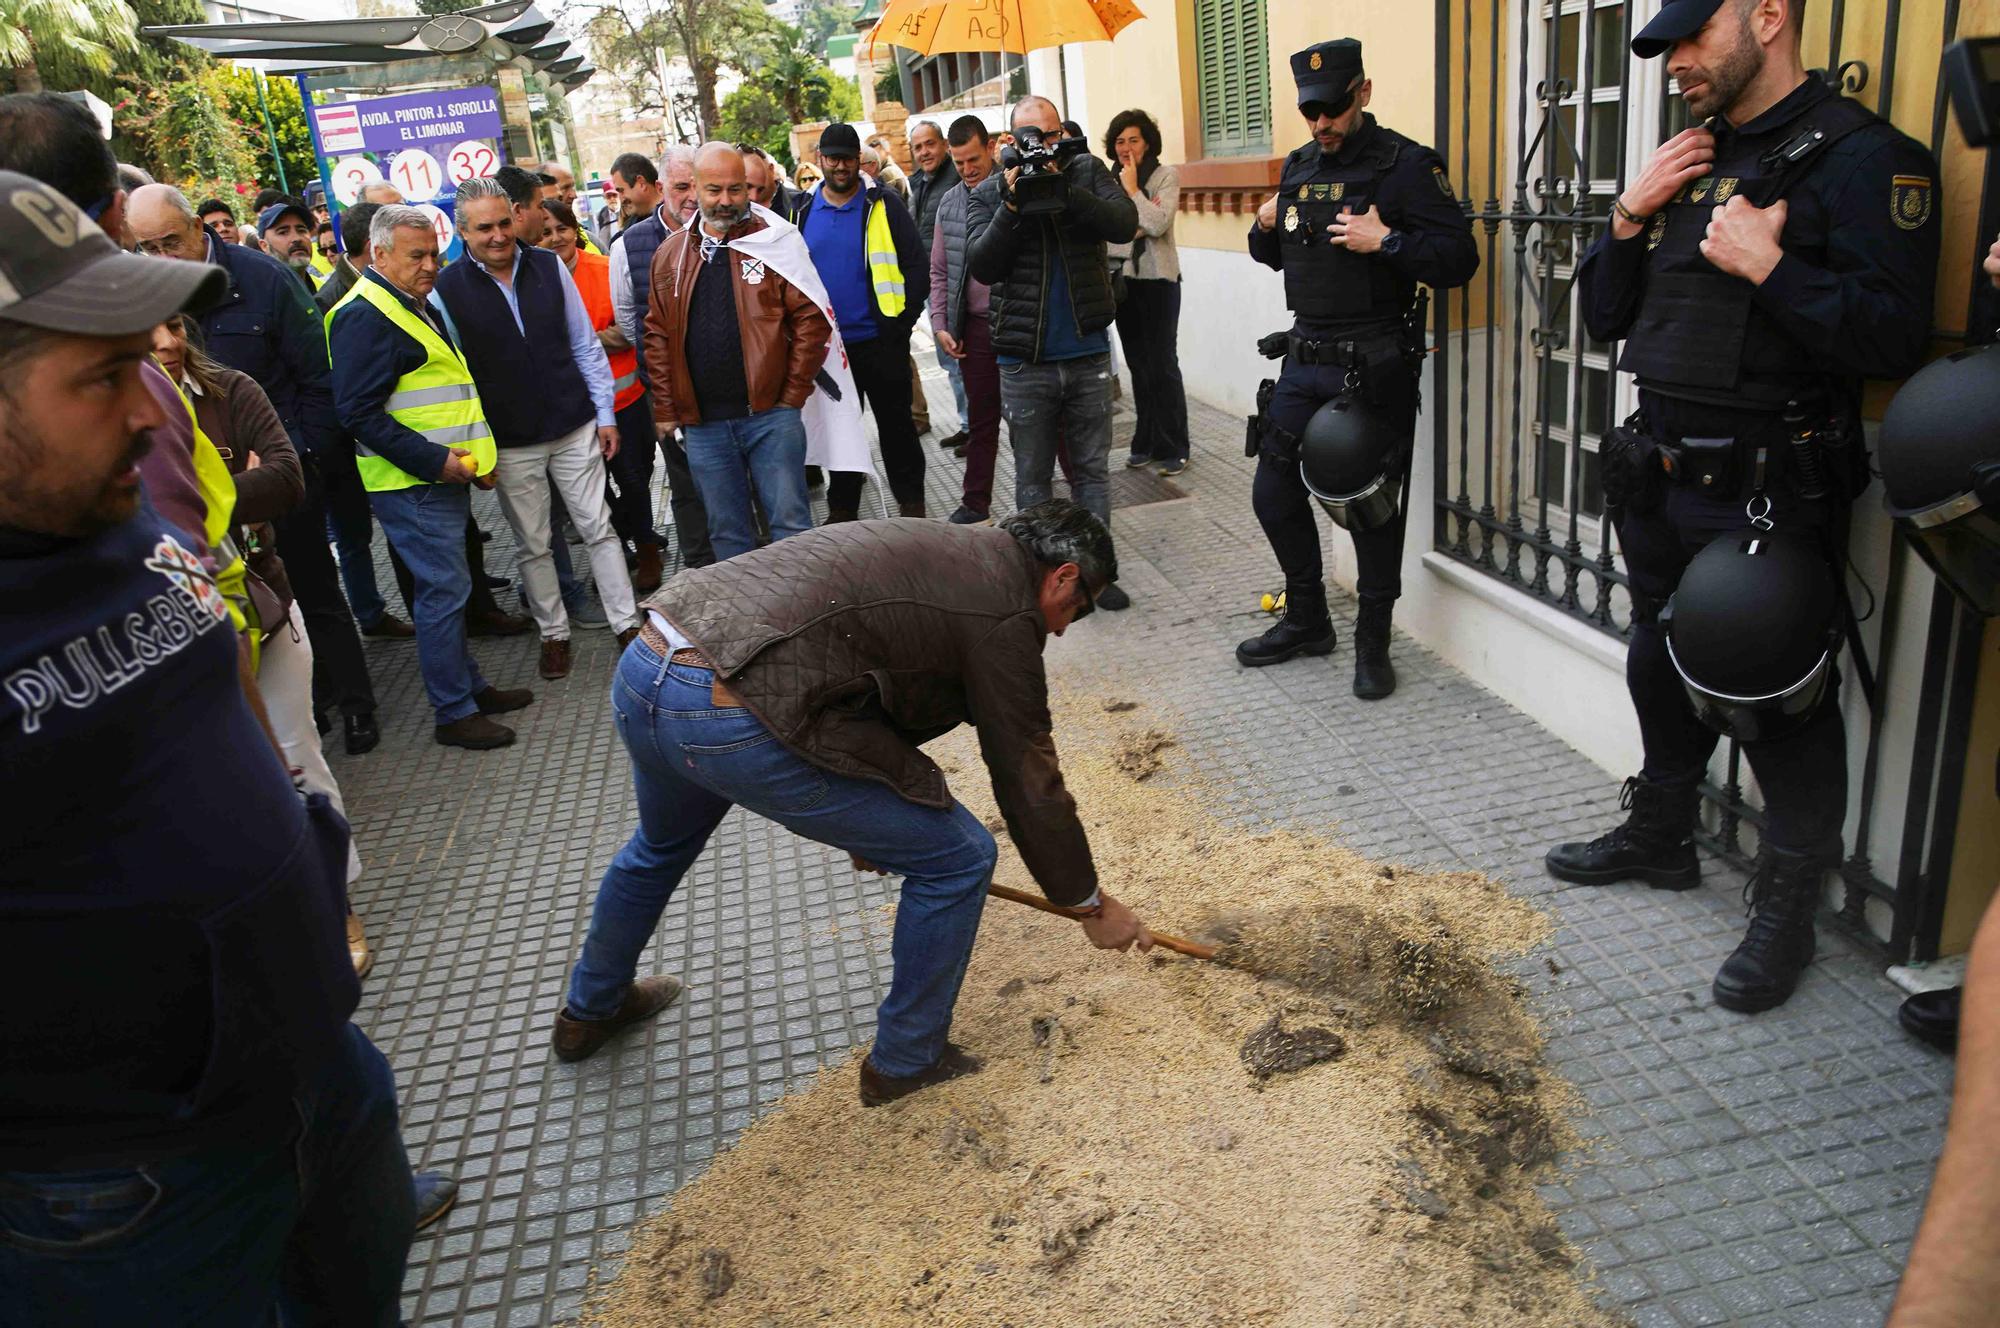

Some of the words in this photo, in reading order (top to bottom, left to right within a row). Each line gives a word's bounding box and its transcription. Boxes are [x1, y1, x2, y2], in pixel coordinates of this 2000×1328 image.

[361, 111, 394, 127] AVDA.
[395, 106, 435, 123] PINTOR
[437, 105, 446, 119] J.
[448, 99, 498, 117] SOROLLA
[400, 127, 415, 140] EL
[416, 121, 465, 139] LIMONAR
[398, 159, 432, 191] 11
[453, 148, 495, 182] 32
[439, 190, 458, 199] Soro
[10, 190, 76, 248] C
[433, 212, 449, 242] 4
[4, 586, 219, 734] PULL&BE
